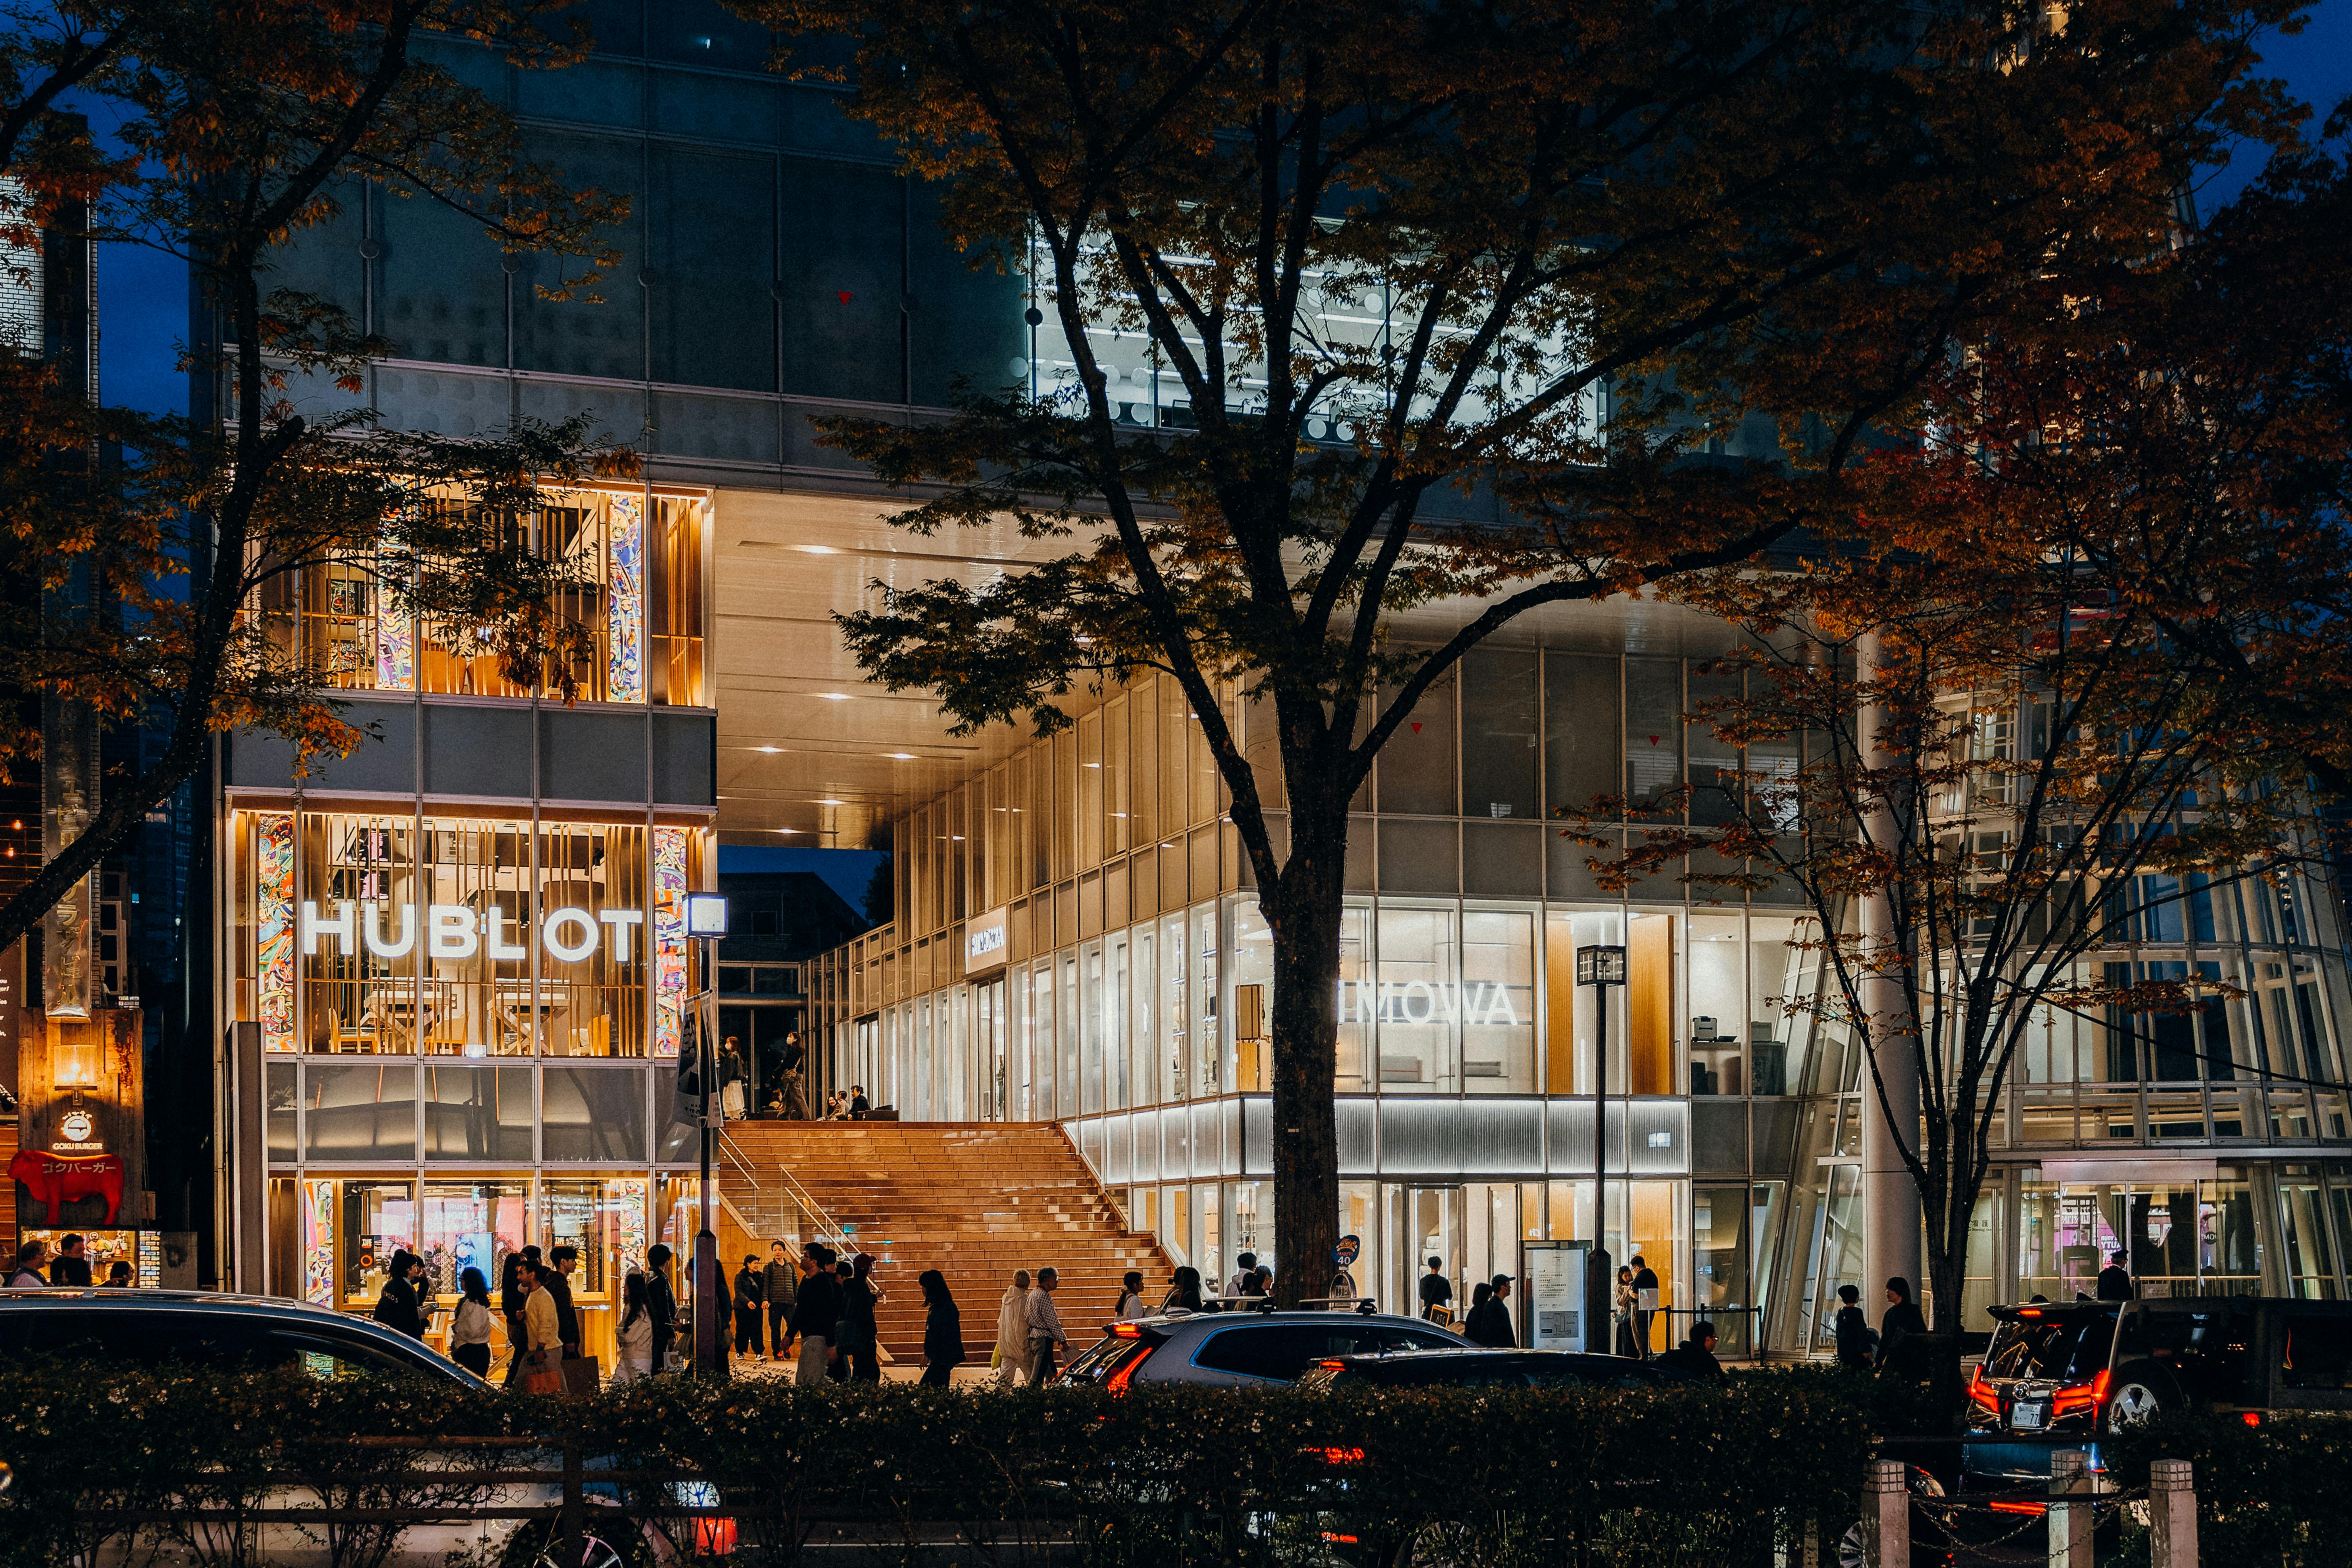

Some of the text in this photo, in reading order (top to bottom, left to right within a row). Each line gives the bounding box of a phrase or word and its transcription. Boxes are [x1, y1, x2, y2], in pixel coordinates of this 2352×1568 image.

[659, 912, 668, 921] 30
[303, 900, 643, 962] HUBLOT
[1338, 979, 1518, 1026] IMOWA
[42, 1162, 116, 1173] ゴクバーガー
[1338, 1256, 1351, 1265] 40
[2030, 1413, 2039, 1424] 77
